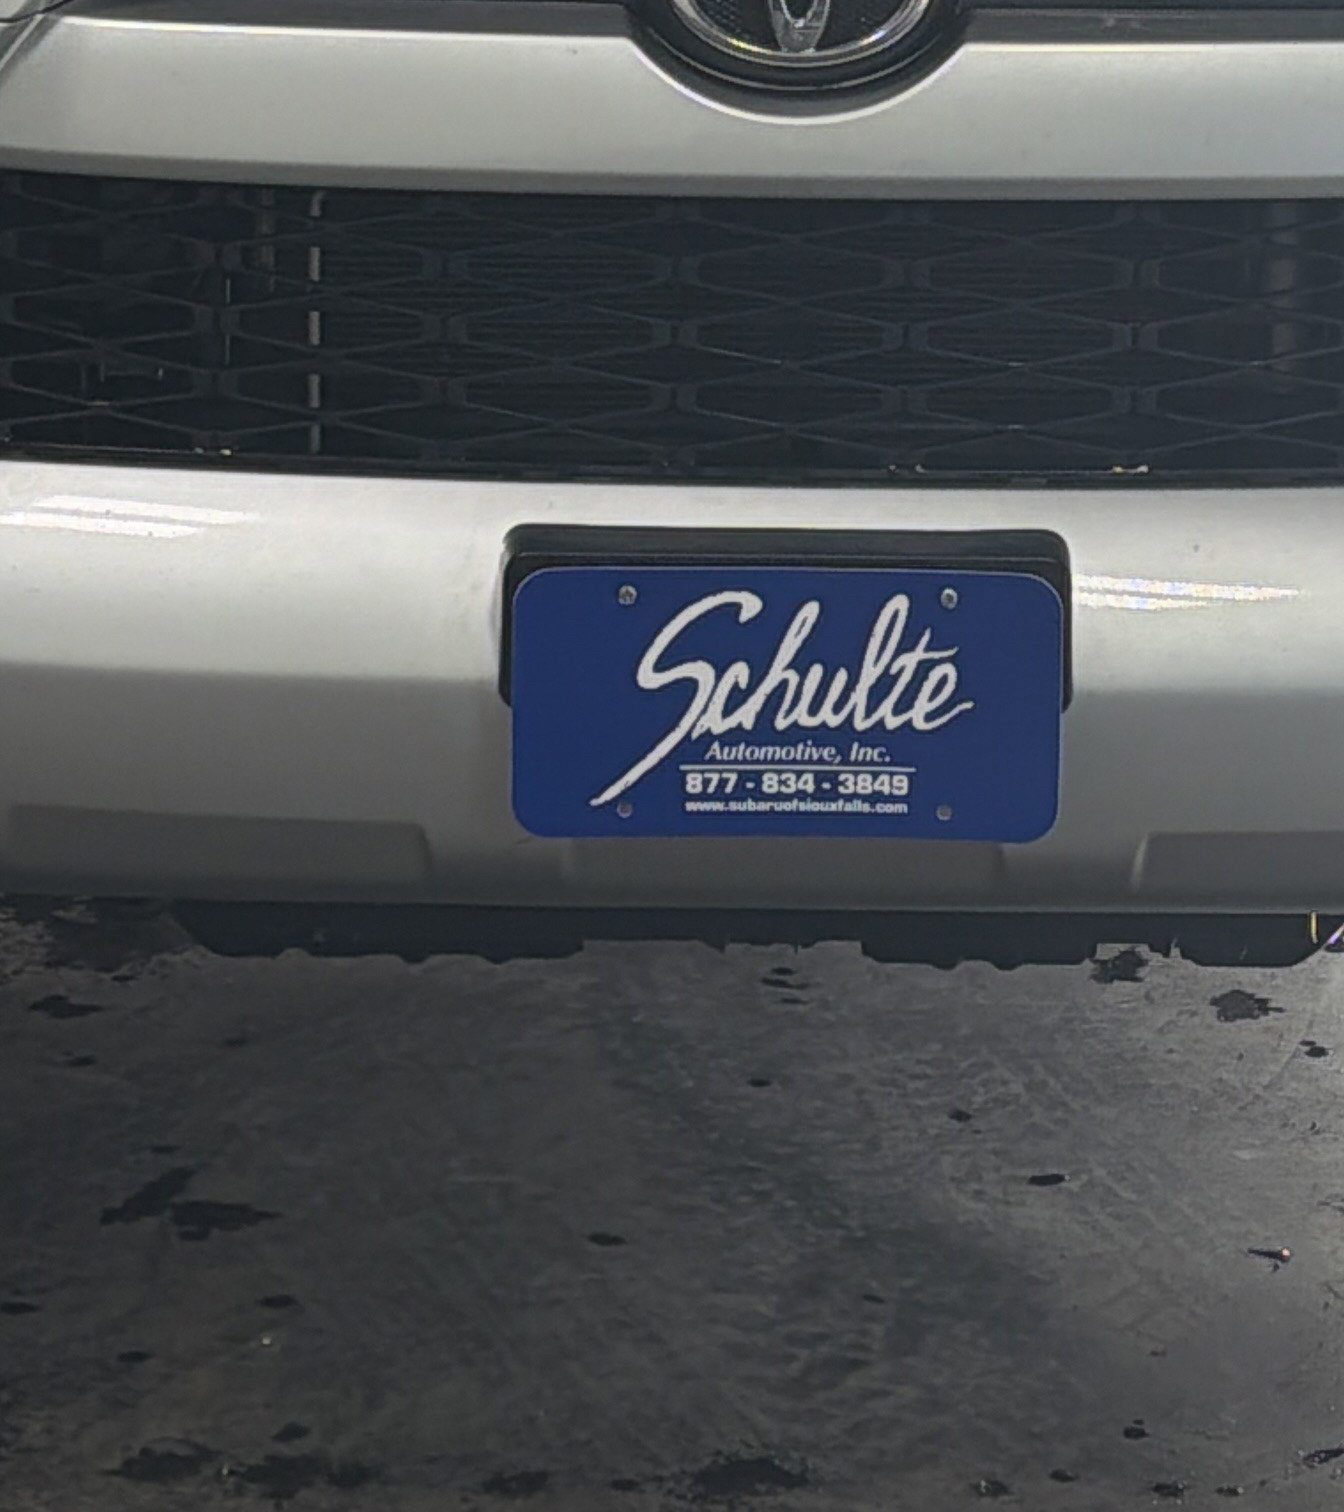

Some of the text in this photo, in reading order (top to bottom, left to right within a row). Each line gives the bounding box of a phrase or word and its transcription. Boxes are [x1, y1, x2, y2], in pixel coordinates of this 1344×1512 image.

[590, 589, 975, 807] Schulte
[704, 740, 891, 764] Automotive, Inc.
[685, 772, 738, 794] 877
[762, 772, 815, 794] 834
[837, 773, 909, 796] 3849
[684, 798, 908, 814] www.subaruofsiouxfalls.com
